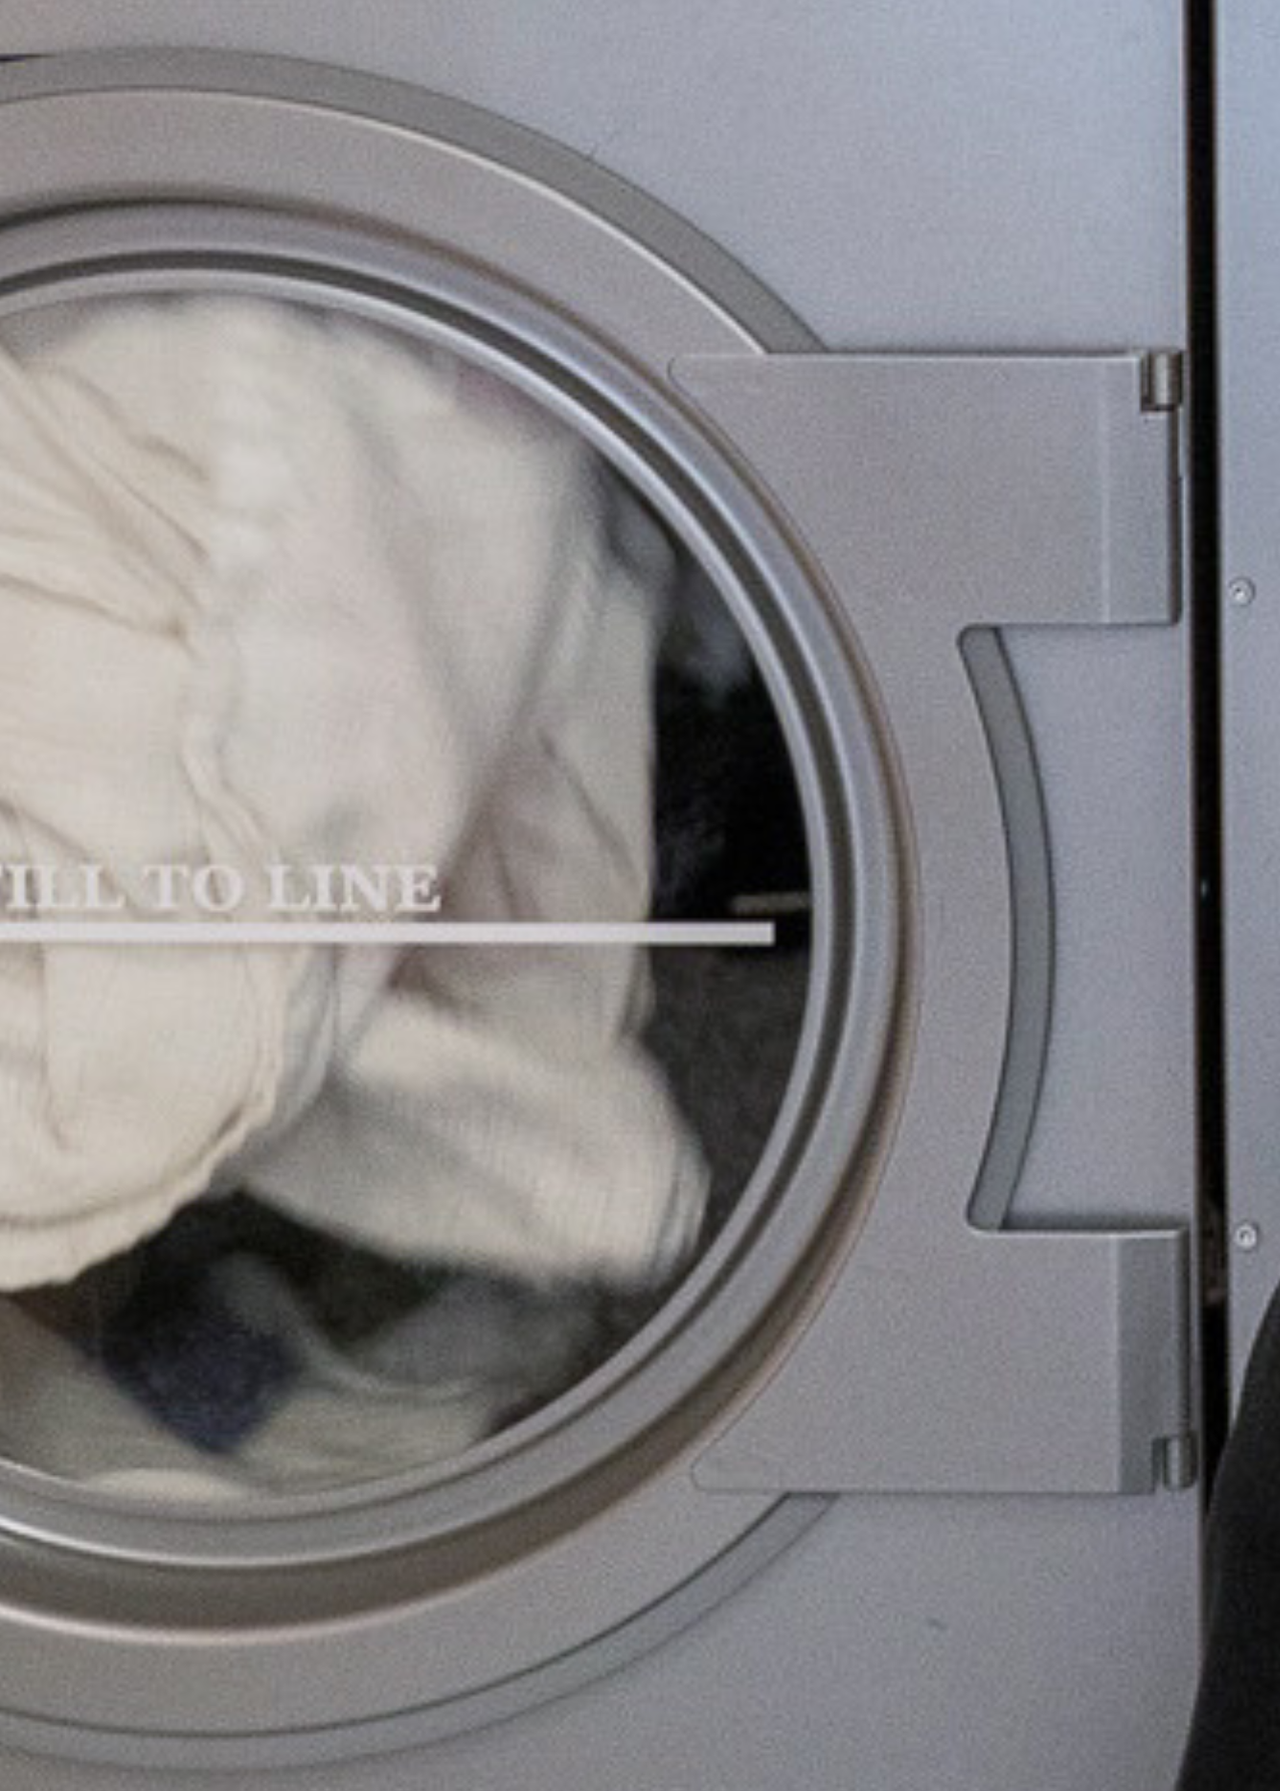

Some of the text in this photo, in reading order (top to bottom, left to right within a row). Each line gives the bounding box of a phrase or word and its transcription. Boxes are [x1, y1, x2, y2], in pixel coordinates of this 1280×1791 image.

[0, 863, 442, 913] ILL TO LINE
